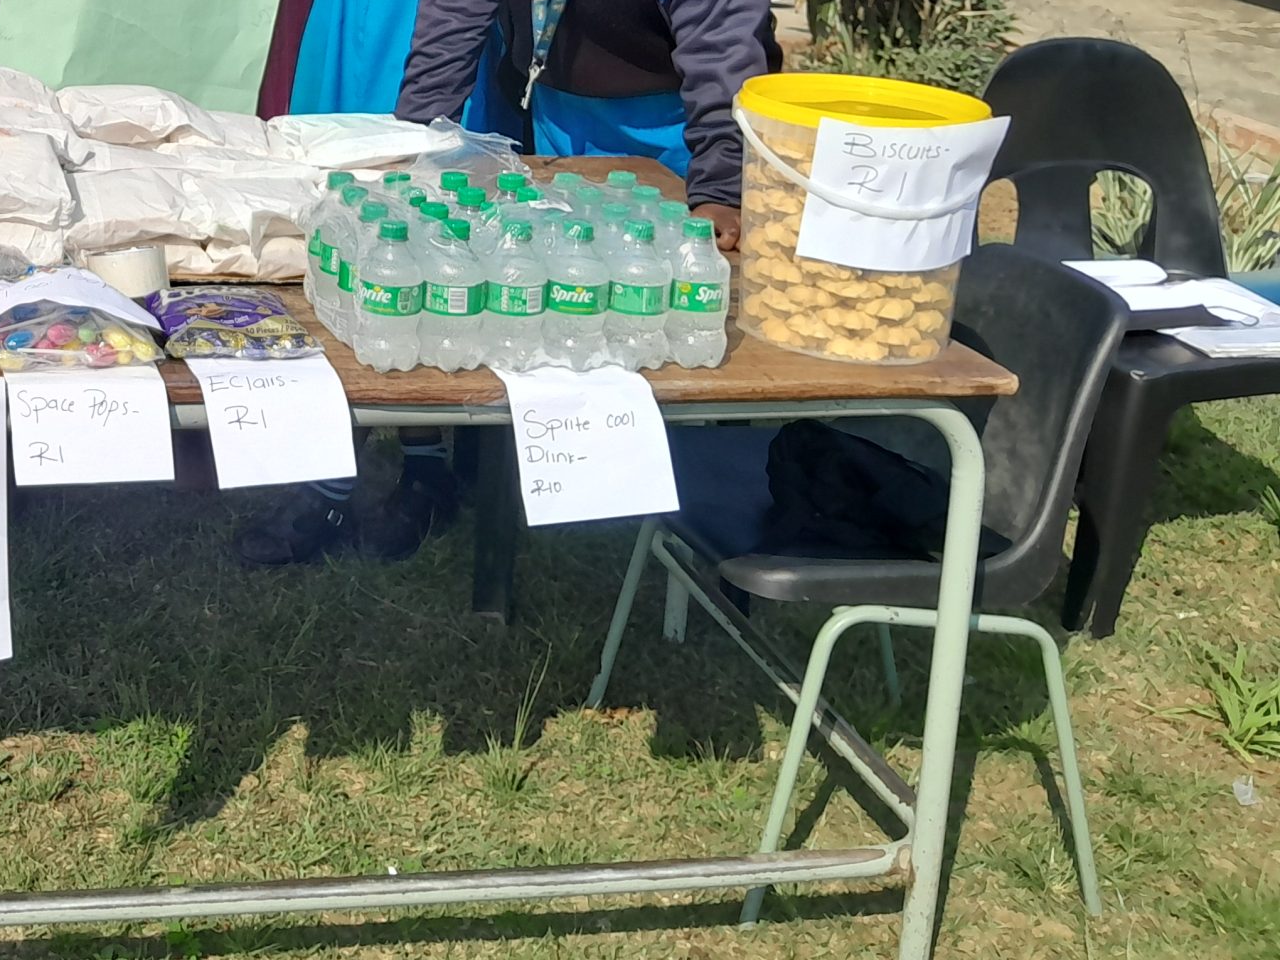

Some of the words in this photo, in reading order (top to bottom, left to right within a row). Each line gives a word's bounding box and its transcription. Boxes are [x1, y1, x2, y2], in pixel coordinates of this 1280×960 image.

[550, 284, 594, 303] Sprite
[17, 390, 75, 424] Space
[224, 405, 267, 430] R1
[523, 409, 591, 441] Sprite
[28, 441, 64, 466] R1
[530, 479, 562, 496] R10
